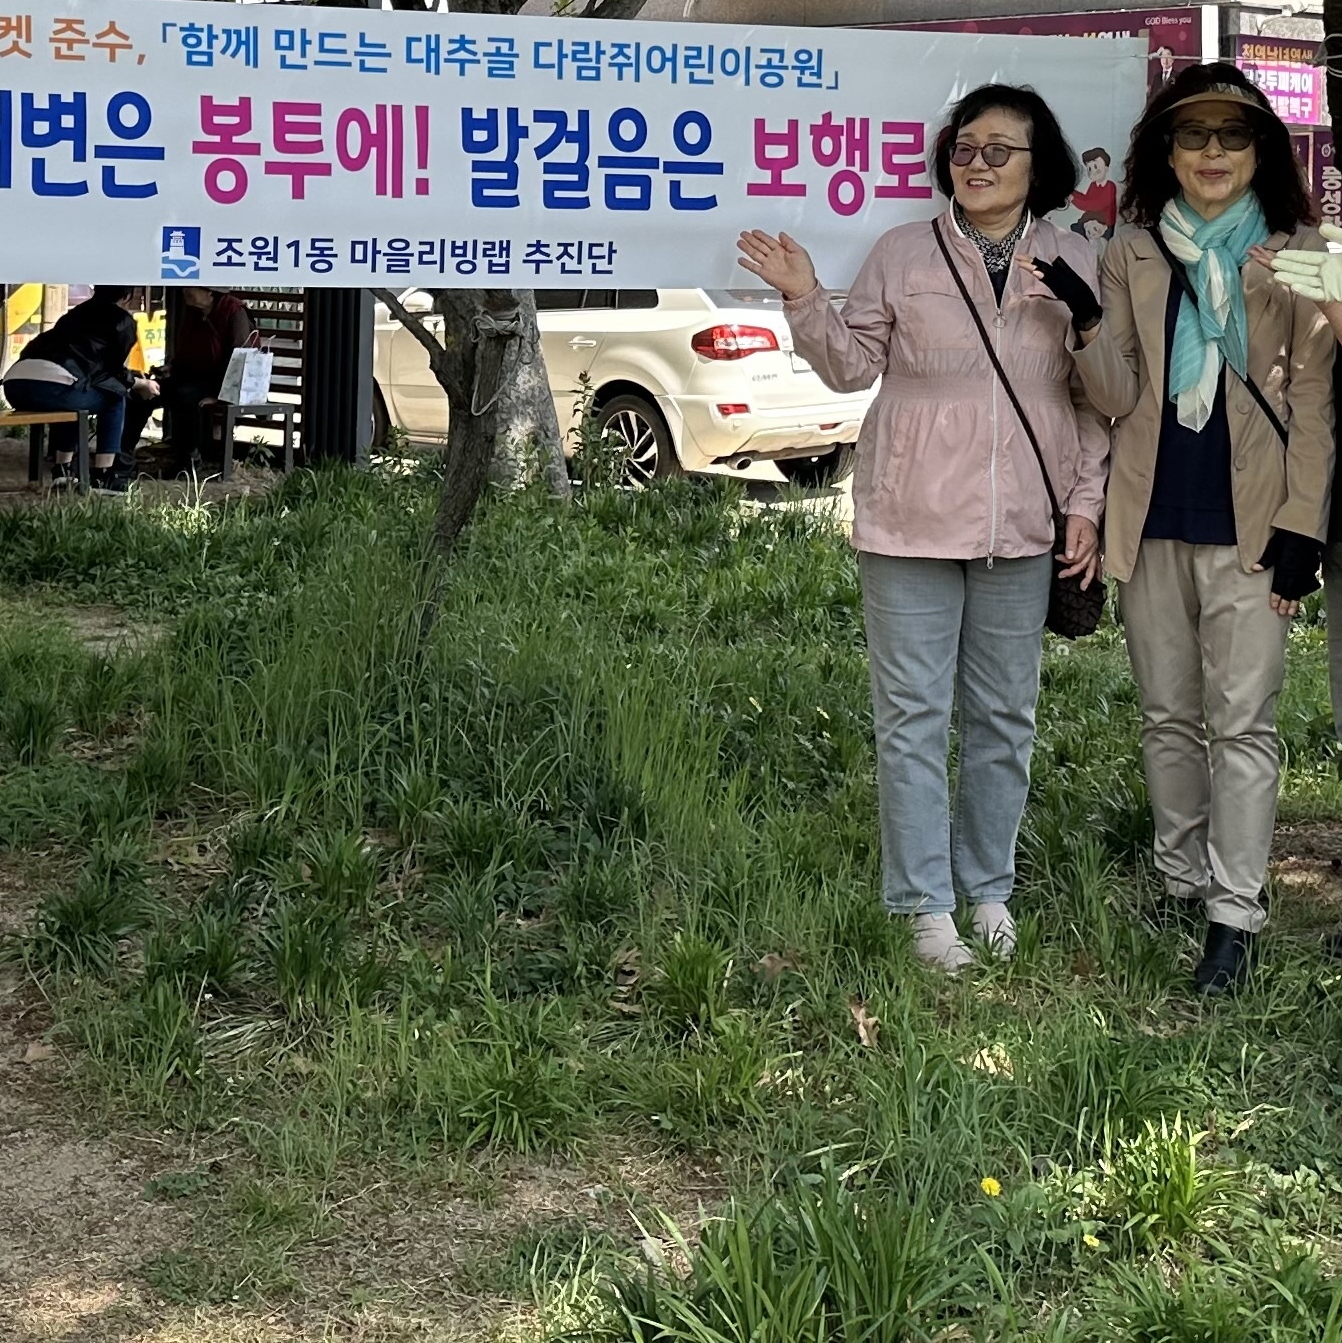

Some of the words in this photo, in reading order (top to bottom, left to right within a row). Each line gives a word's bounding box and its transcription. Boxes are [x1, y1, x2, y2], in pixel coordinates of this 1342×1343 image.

[1145, 17, 1160, 26] GOD
[1179, 17, 1192, 25] you
[48, 18, 146, 66] 준수,
[273, 28, 393, 74] 만드는
[405, 33, 520, 80] 대추골
[191, 94, 429, 206] 봉투에!
[461, 107, 724, 212] 발걸음은
[747, 111, 947, 217] 보행로
[212, 236, 339, 274] 조원1동
[351, 237, 511, 275] 마을리빙랩
[522, 239, 618, 275] 추진단
